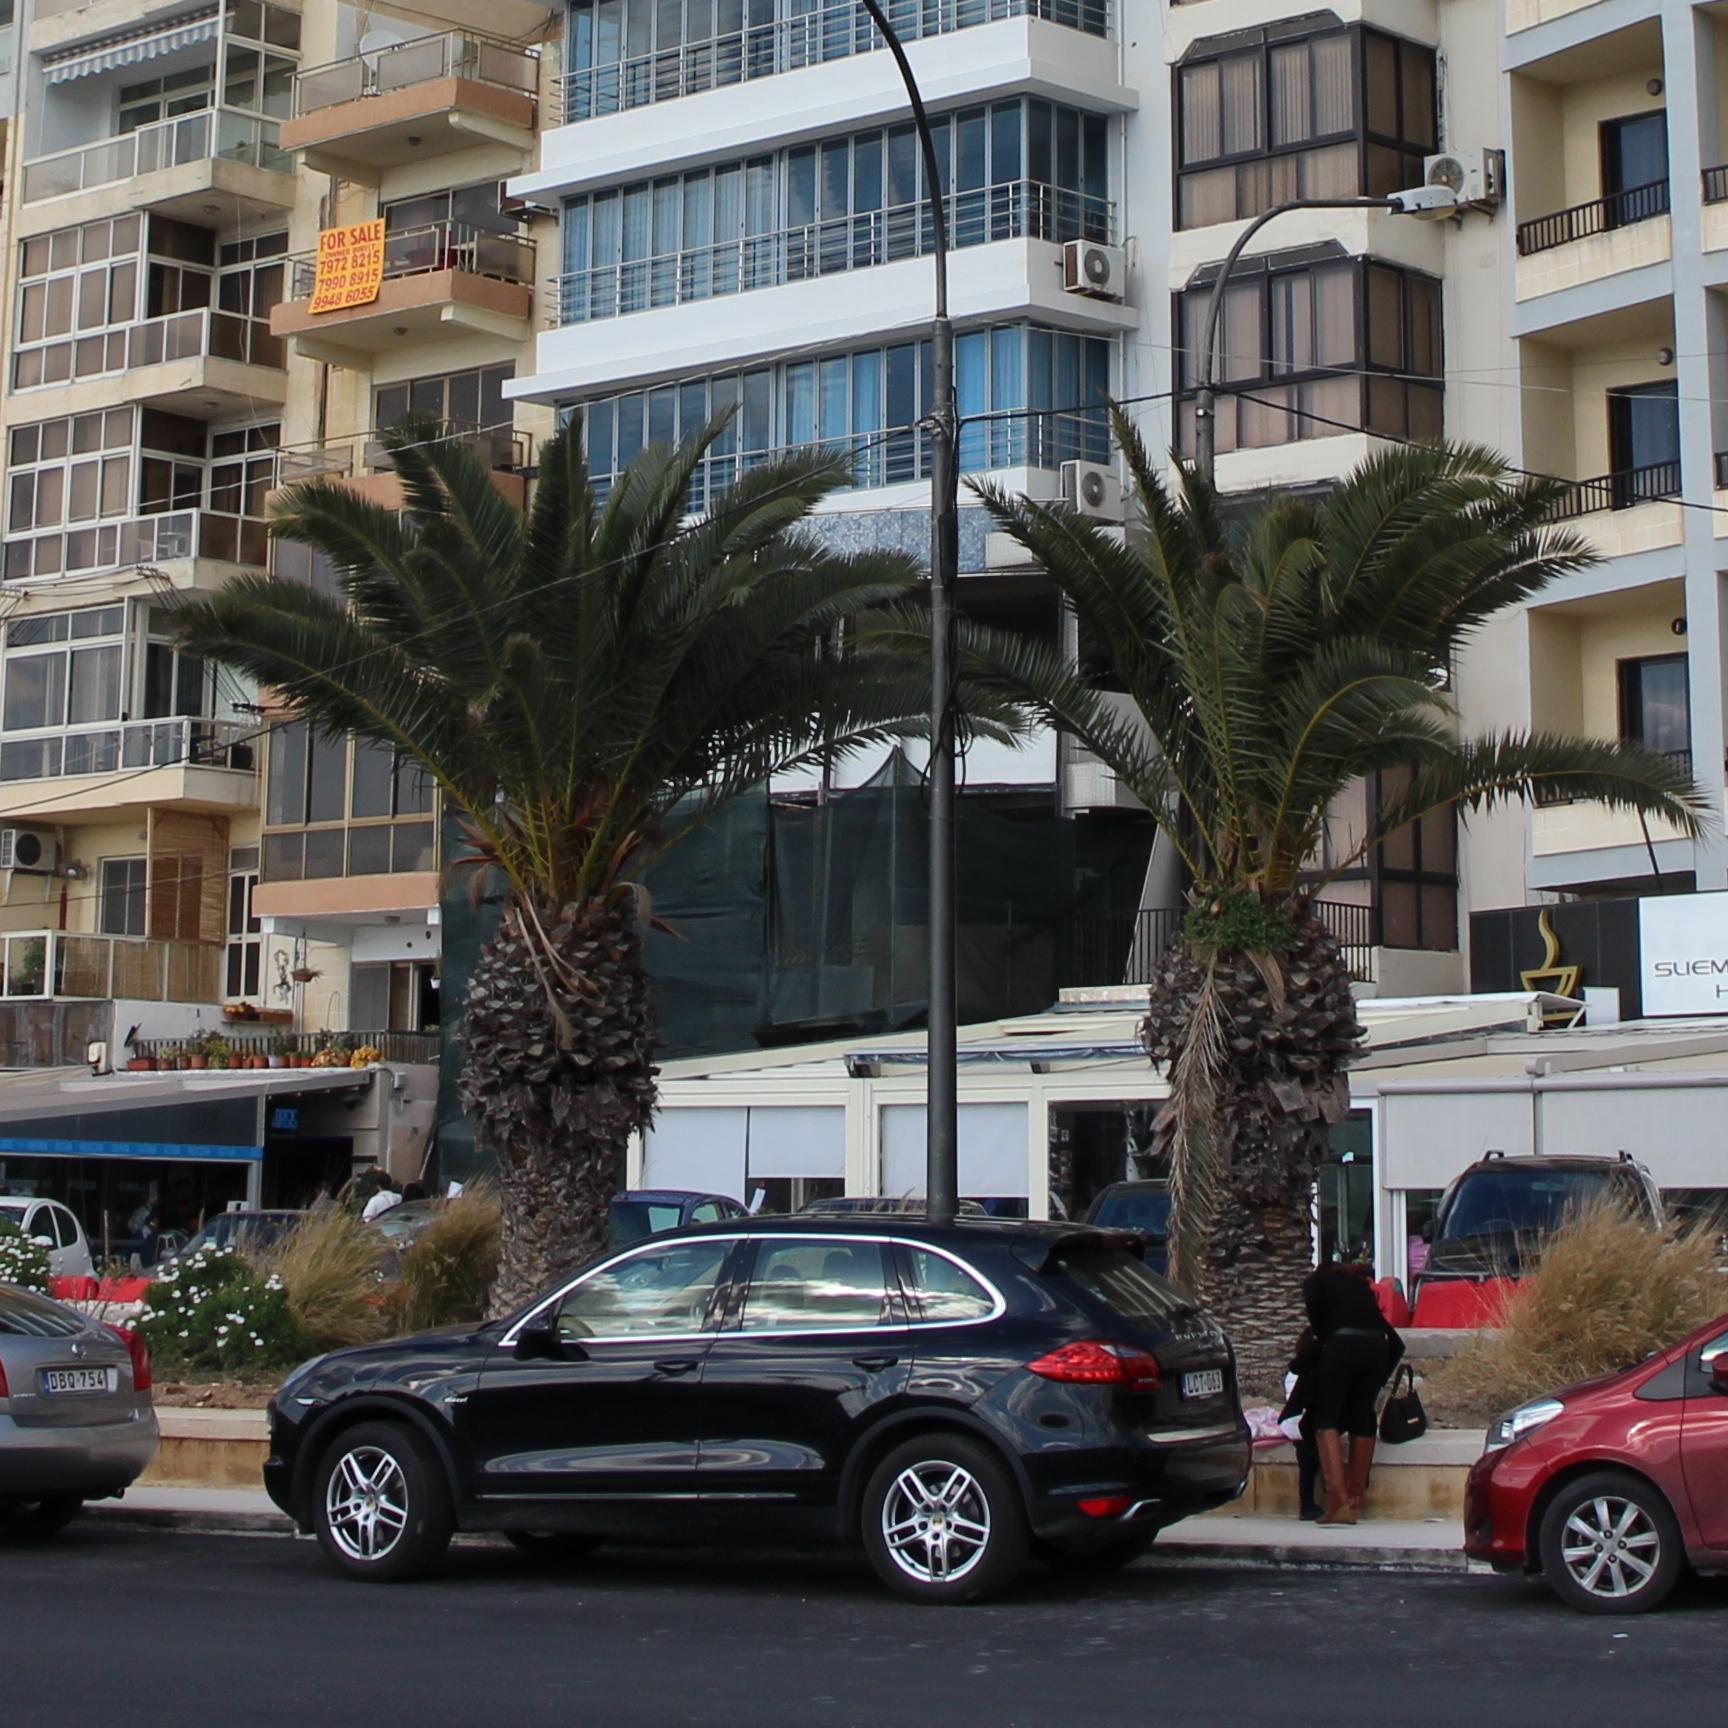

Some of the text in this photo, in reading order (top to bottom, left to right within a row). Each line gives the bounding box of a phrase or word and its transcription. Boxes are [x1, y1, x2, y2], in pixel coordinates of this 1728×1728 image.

[320, 223, 381, 252] FOR SALE
[320, 250, 380, 274] 7972 8215
[318, 268, 378, 295] 7990 8915
[313, 293, 342, 310] 9948
